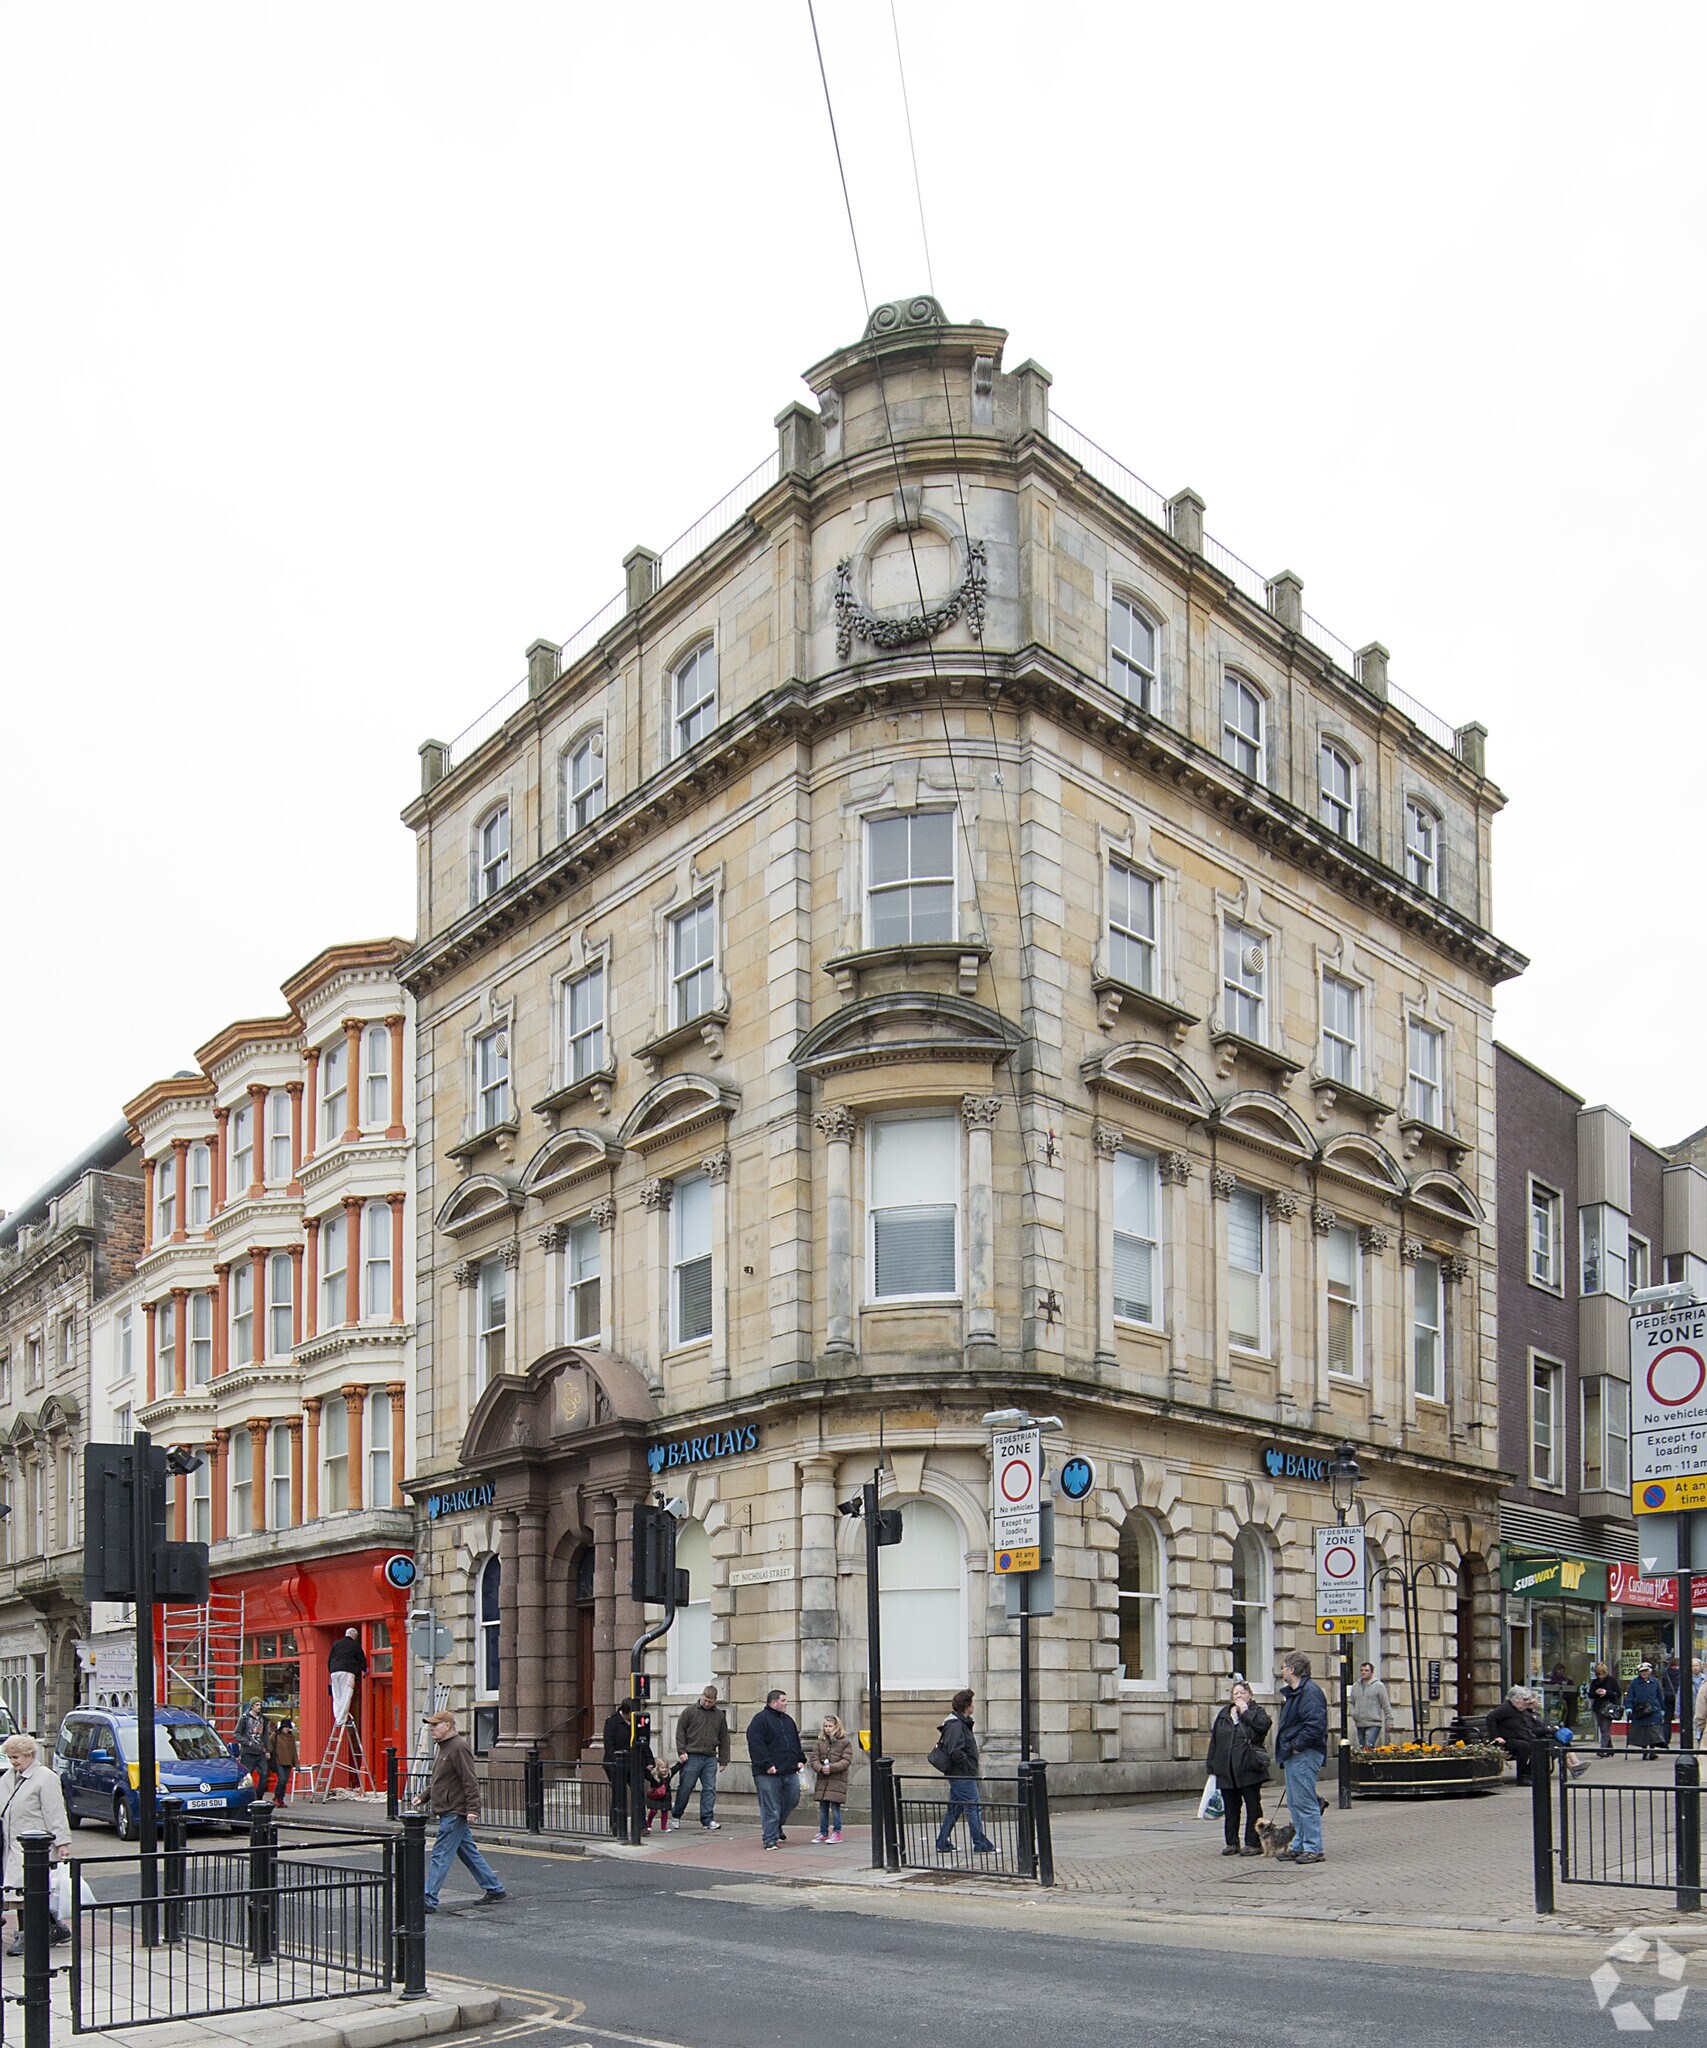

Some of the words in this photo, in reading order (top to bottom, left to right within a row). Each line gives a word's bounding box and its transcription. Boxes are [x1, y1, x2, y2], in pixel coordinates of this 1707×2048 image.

[1636, 1309, 1706, 1330] PEDESTRIA
[1648, 1323, 1704, 1347] ZONE
[1644, 1414, 1660, 1424] No
[995, 1432, 1037, 1445] PEDESTRIAN
[1647, 1432, 1686, 1446] Except
[1690, 1430, 1706, 1440] for
[668, 1424, 757, 1466] BARCLAYS
[1001, 1443, 1031, 1457] ZONE
[1656, 1444, 1698, 1456] loading
[1286, 1454, 1332, 1480] BARC
[1645, 1464, 1653, 1473] 4
[1655, 1464, 1672, 1474] pm
[1681, 1460, 1690, 1469] 11
[1675, 1482, 1688, 1492] At
[1692, 1480, 1707, 1491] an
[1681, 1494, 1706, 1505] time
[1000, 1506, 1009, 1514] No
[1010, 1503, 1034, 1512] vehicles
[1001, 1519, 1022, 1528] Except
[1023, 1517, 1032, 1525] for
[1005, 1527, 1028, 1536] loading
[1005, 1539, 1015, 1547] pm
[1325, 1535, 1355, 1546] ZONE
[1024, 1551, 1035, 1559] any
[741, 1570, 769, 1583] NICHOLAS
[769, 1568, 791, 1578] STREET
[1513, 1565, 1560, 1592] SUBWAY
[1628, 1576, 1655, 1596] Cushion
[1621, 1668, 1640, 1676] £20
[191, 1800, 208, 1808] SG61
[208, 1799, 223, 1807] SDU
